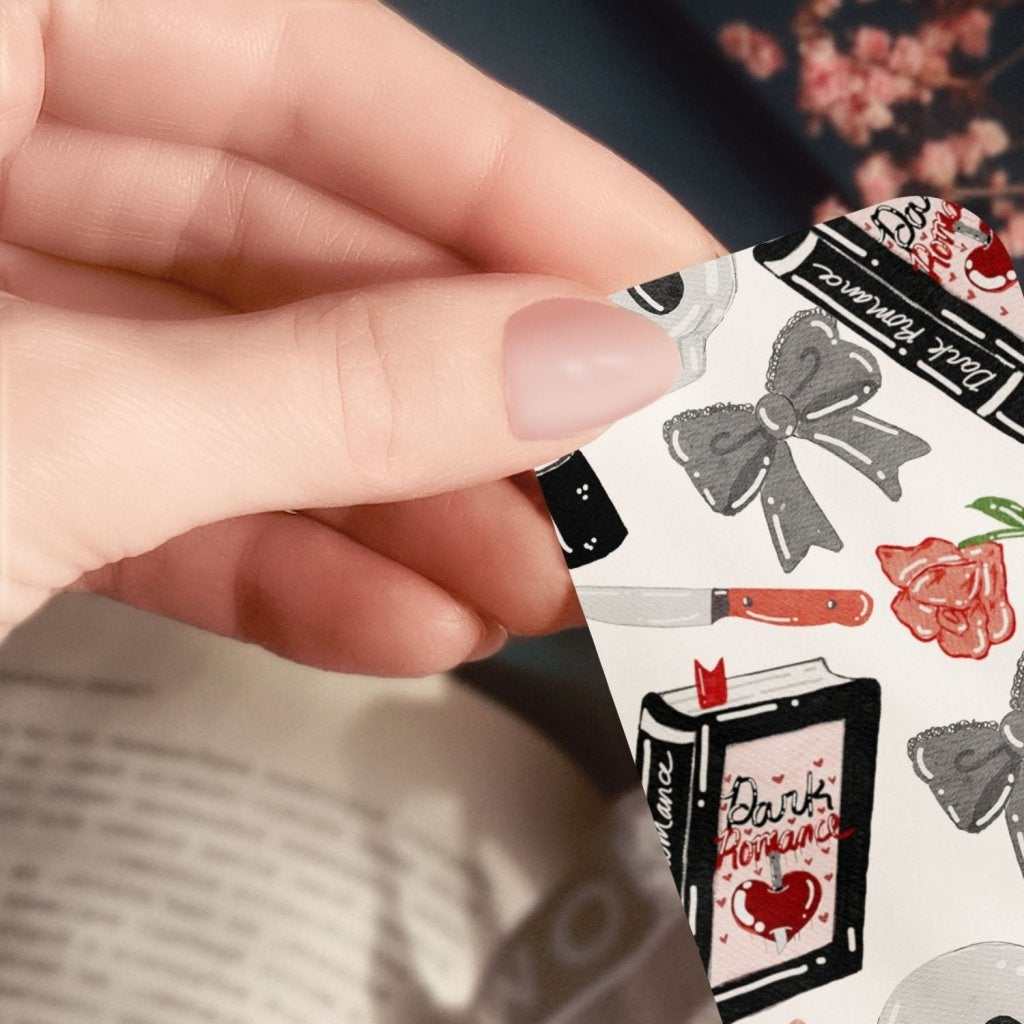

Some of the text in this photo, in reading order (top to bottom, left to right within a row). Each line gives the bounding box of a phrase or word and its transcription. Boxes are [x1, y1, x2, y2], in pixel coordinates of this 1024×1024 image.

[870, 196, 931, 254] Da
[911, 200, 962, 286] Roma
[812, 262, 998, 393] Dark Romance
[720, 771, 834, 830] Dark
[713, 812, 858, 871] Romance
